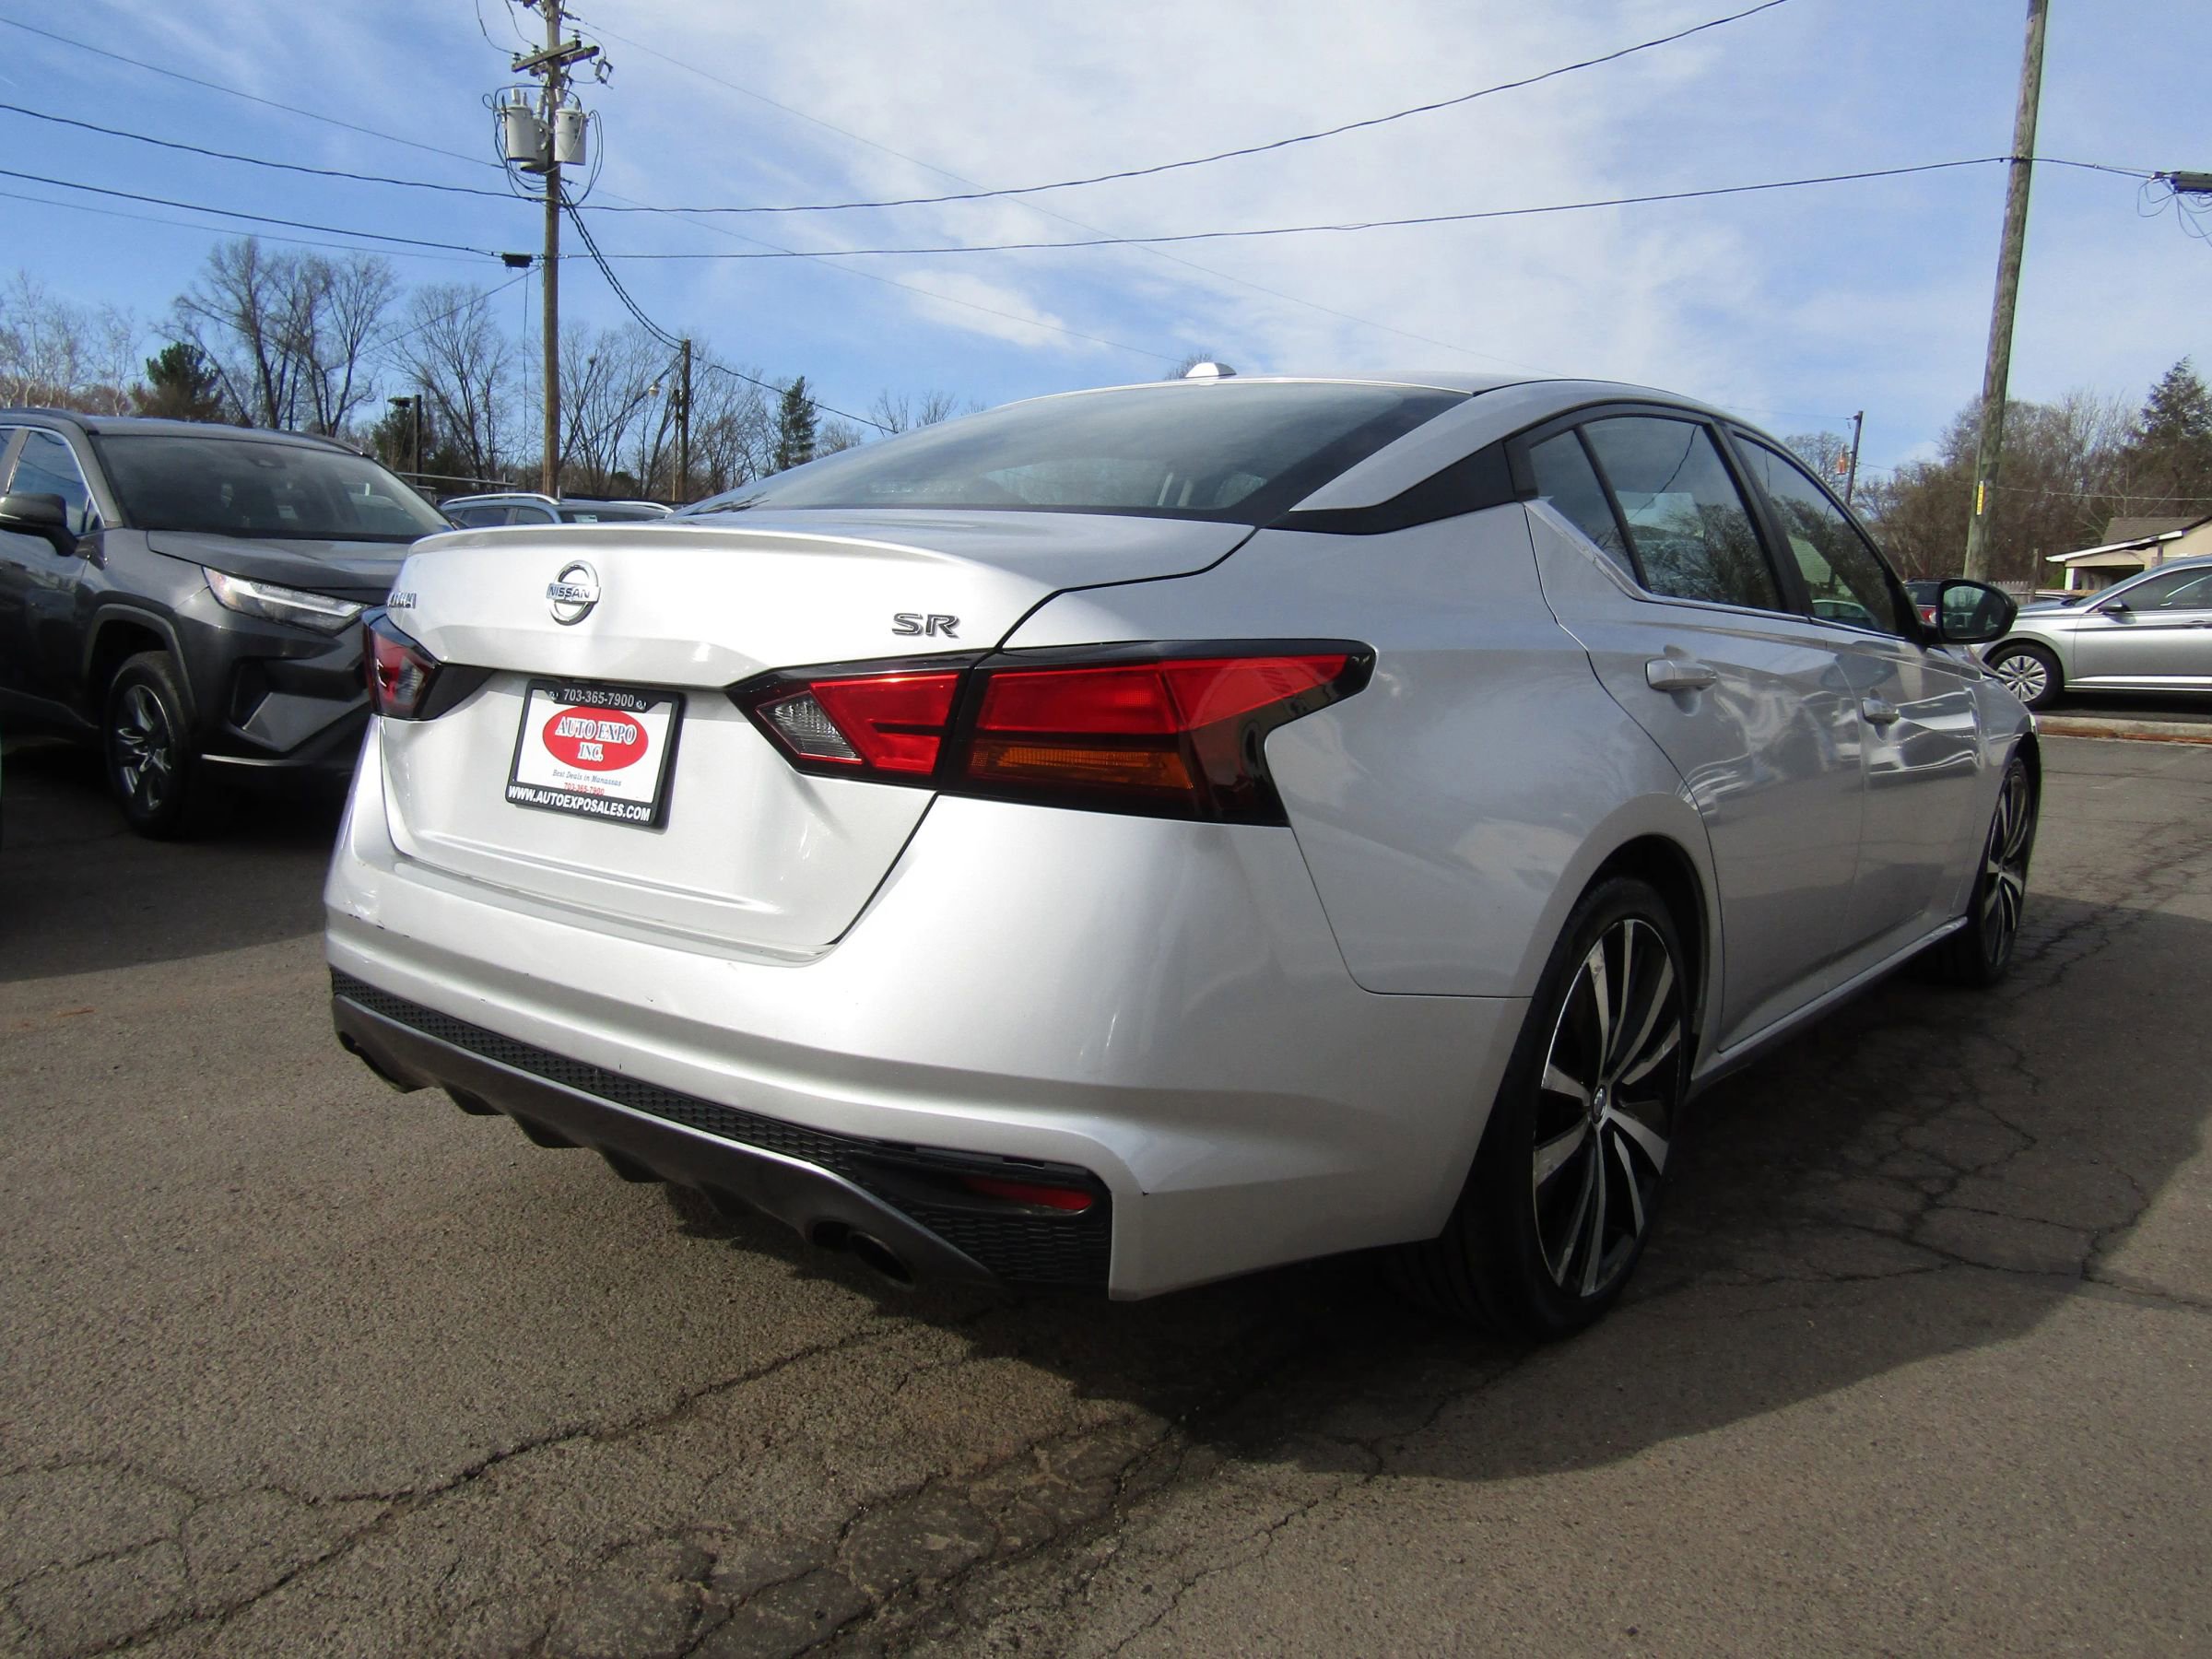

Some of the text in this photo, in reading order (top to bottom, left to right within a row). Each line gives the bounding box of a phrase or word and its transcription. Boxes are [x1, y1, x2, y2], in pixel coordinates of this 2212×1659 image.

[548, 586, 591, 599] NISSAN
[891, 612, 960, 639] SR
[563, 688, 635, 708] 703-365-7900
[556, 717, 637, 745] AUTO EXPO
[578, 743, 604, 761] INC.
[552, 769, 565, 777] Best
[566, 771, 582, 781] Deals
[591, 775, 622, 786] Manassas
[508, 785, 651, 821] WWW.AUTOEXPOSALES.COM
